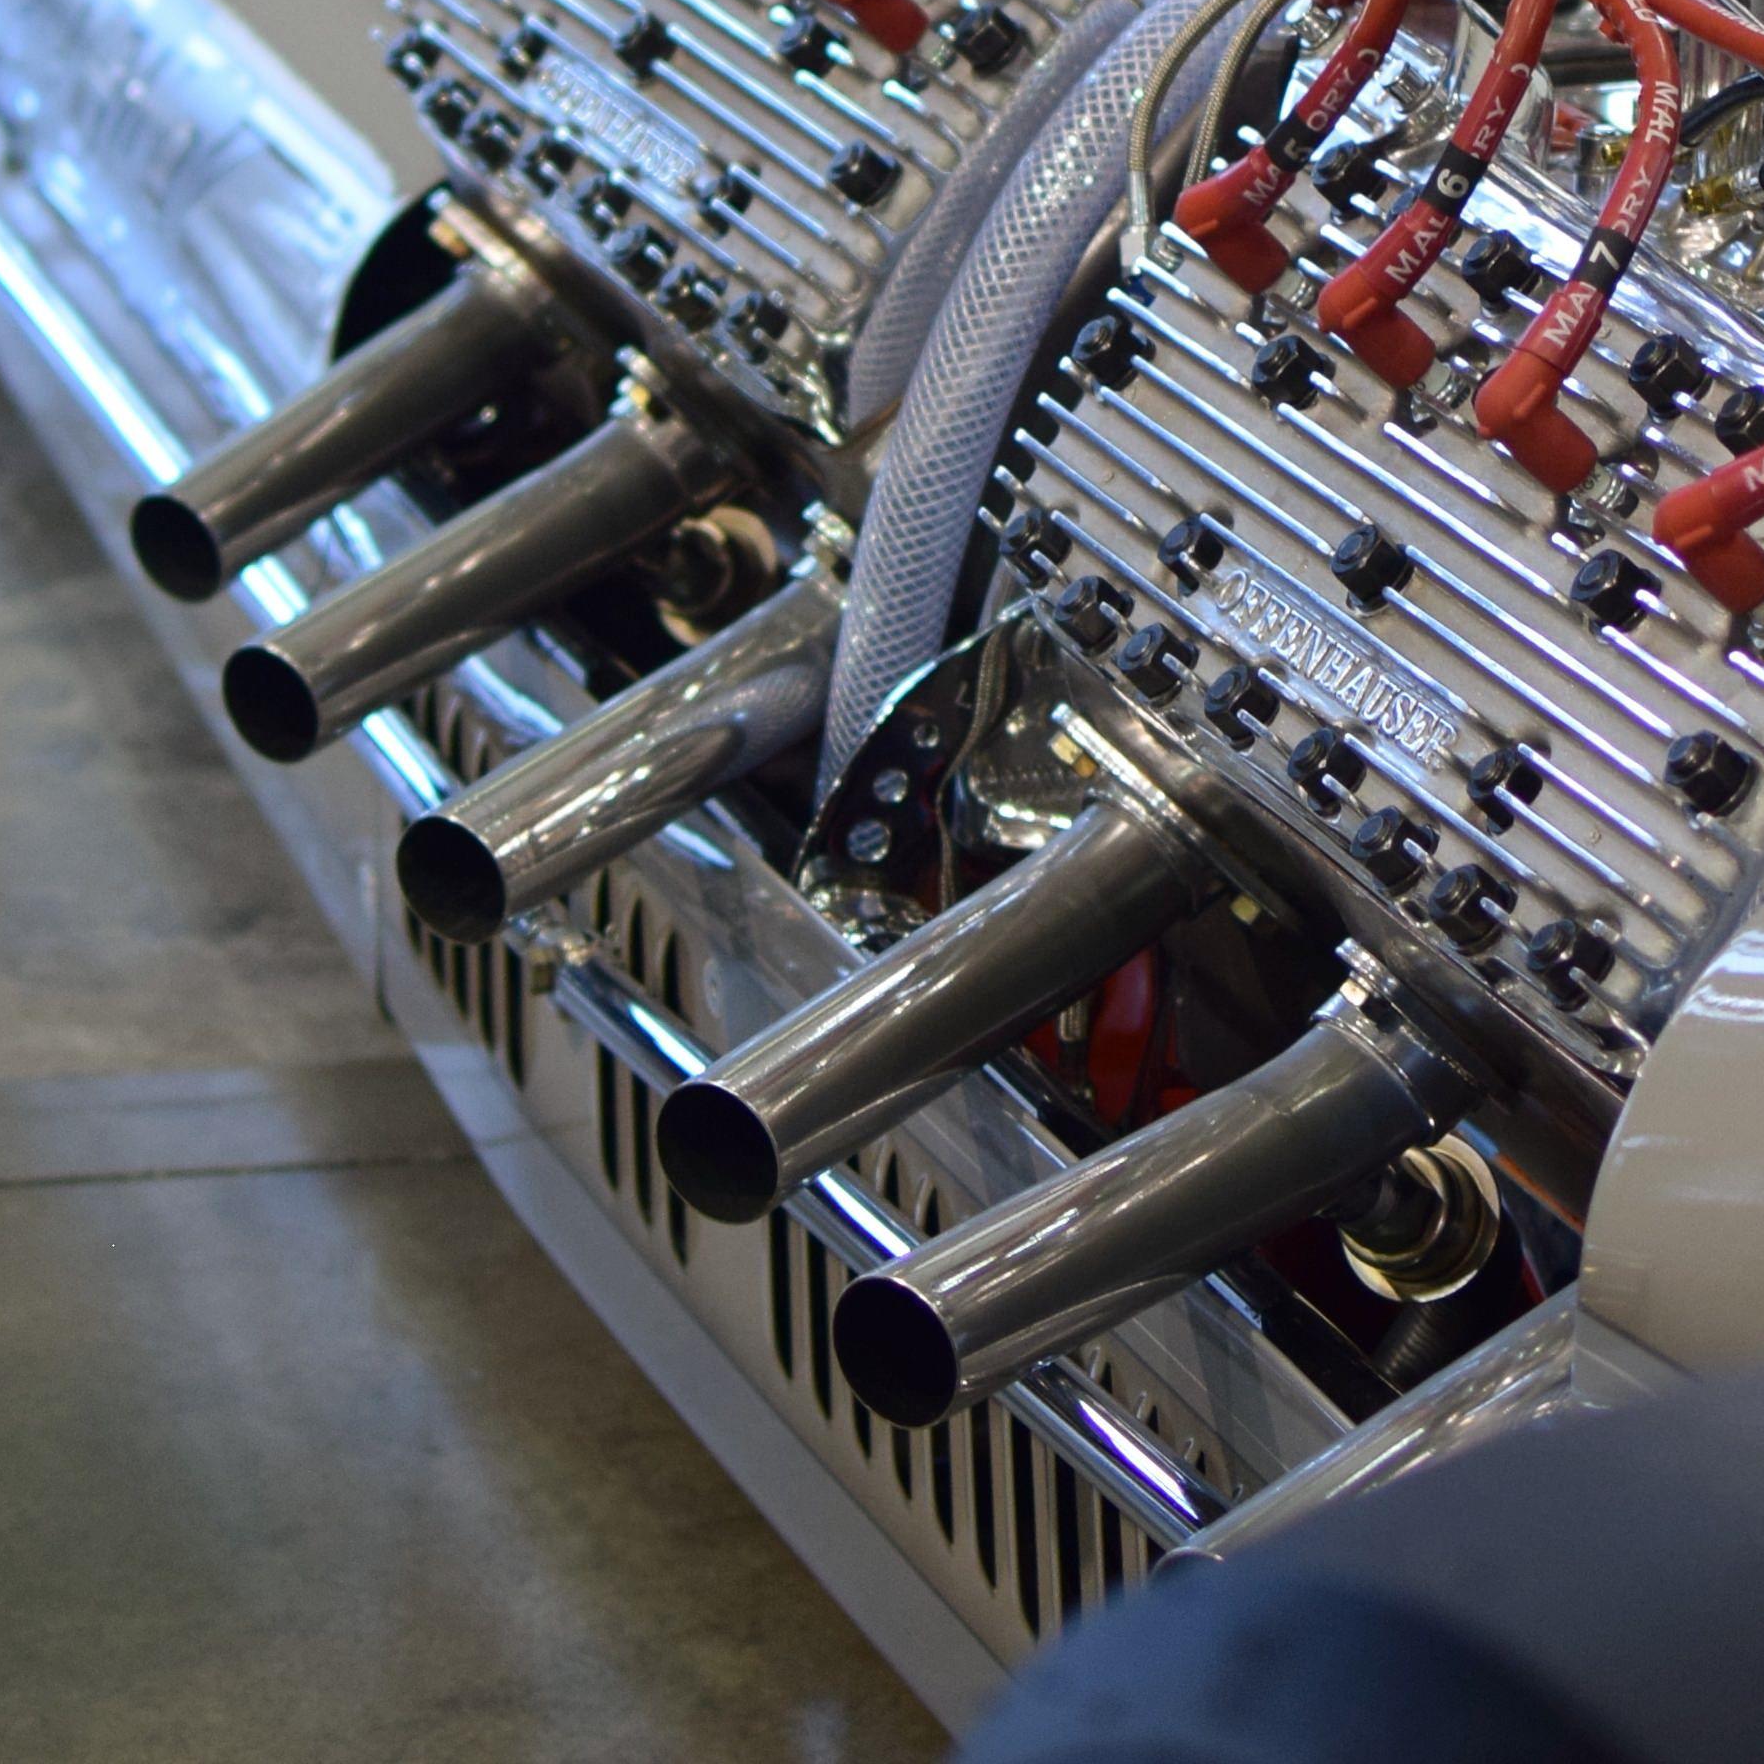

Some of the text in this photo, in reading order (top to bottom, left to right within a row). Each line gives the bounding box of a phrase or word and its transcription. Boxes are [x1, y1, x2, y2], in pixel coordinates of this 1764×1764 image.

[1436, 167, 1470, 199] 6
[1588, 239, 1621, 272] 7
[1215, 569, 1458, 773] OFFENHAUSER
